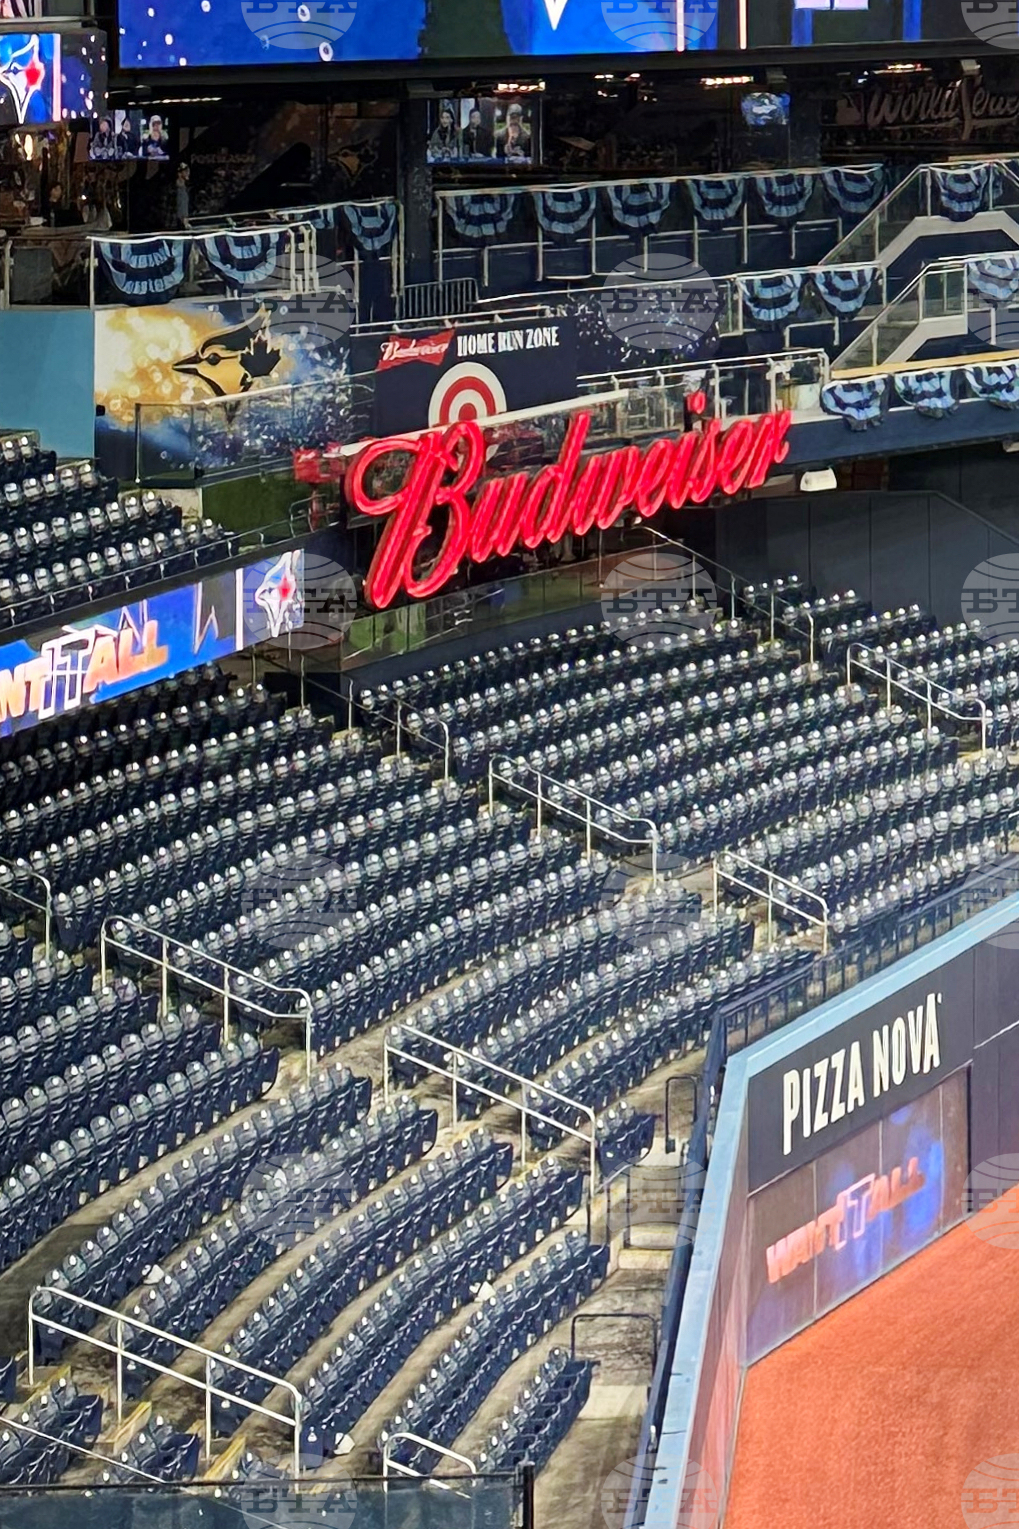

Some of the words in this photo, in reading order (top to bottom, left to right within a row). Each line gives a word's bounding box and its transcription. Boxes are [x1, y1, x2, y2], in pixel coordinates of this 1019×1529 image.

[457, 332, 496, 356] HOME
[497, 329, 525, 352] RUN
[526, 326, 560, 349] ZONE
[344, 389, 792, 609] Budweiser
[783, 1040, 865, 1156] PIZZA
[872, 992, 941, 1099] NOVA
